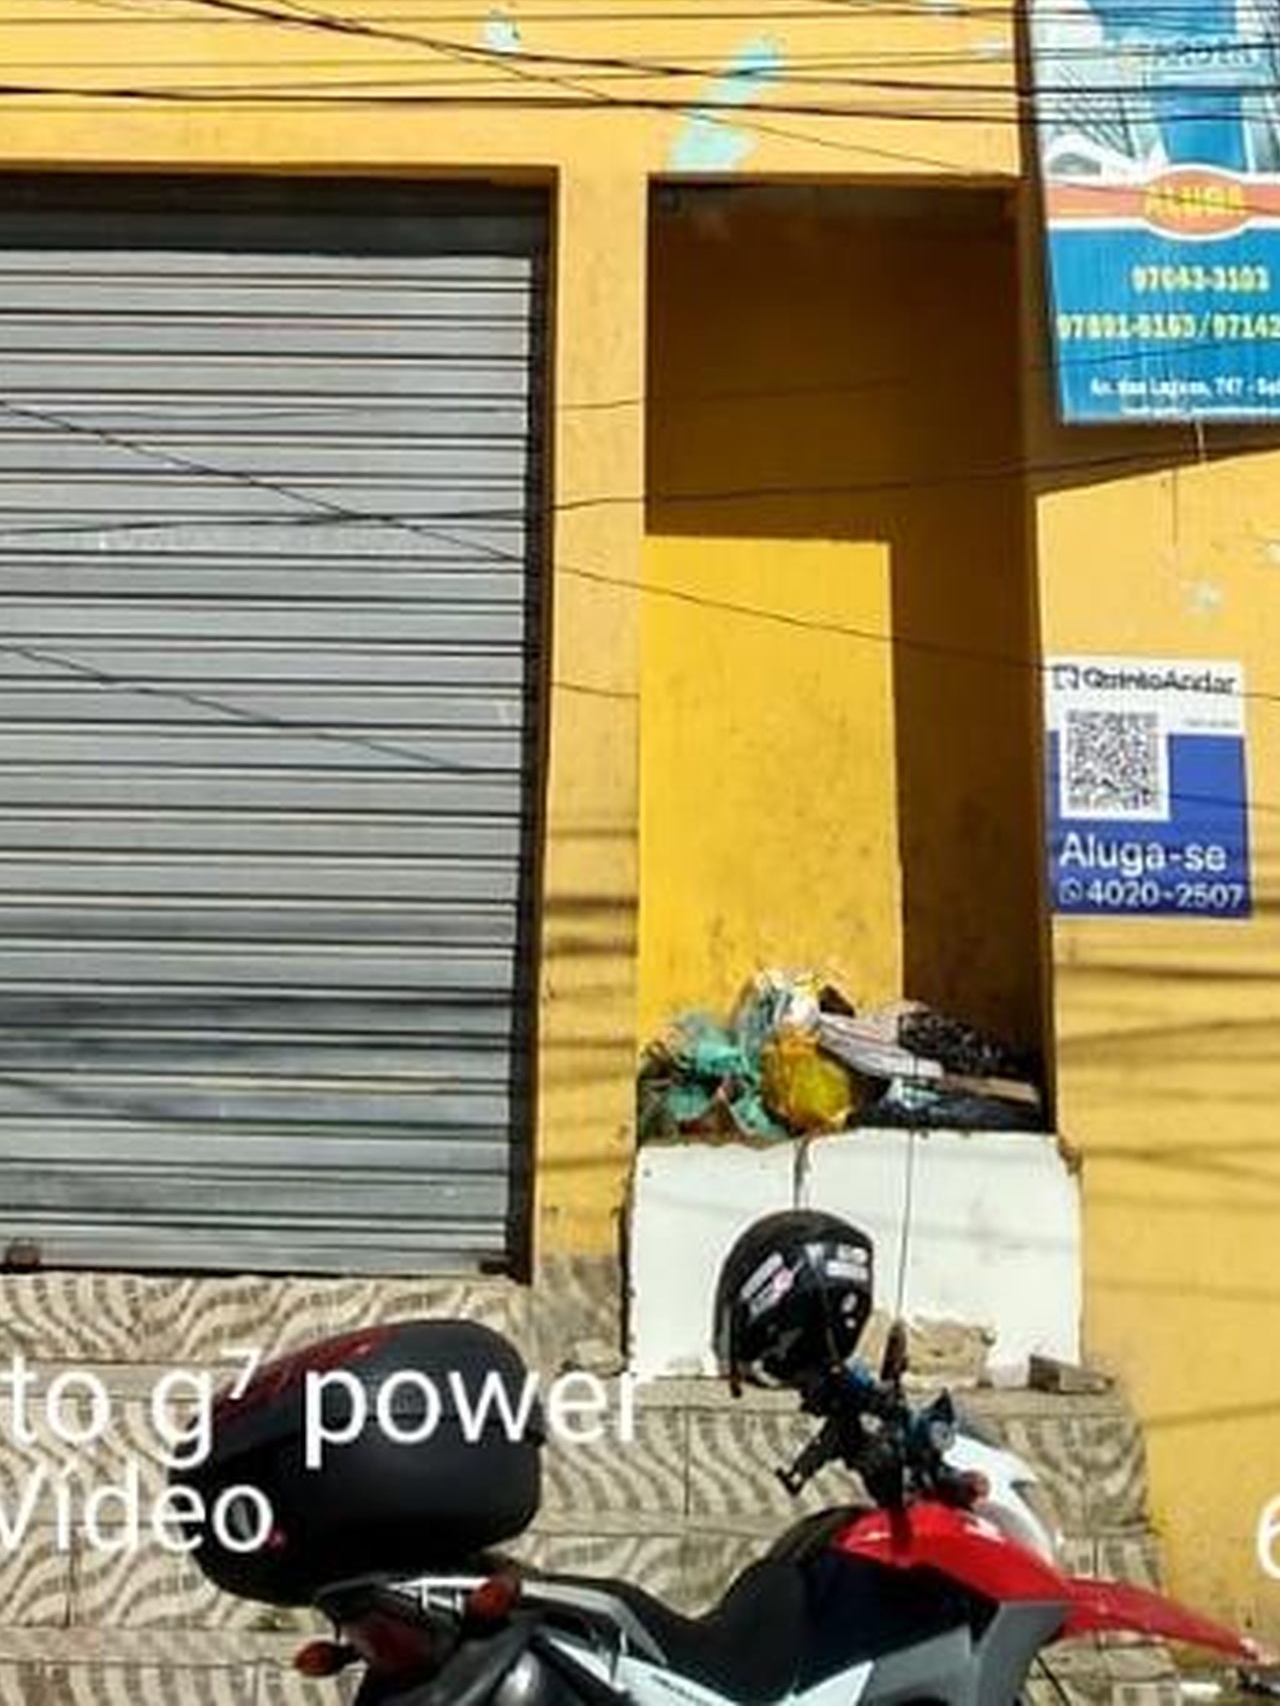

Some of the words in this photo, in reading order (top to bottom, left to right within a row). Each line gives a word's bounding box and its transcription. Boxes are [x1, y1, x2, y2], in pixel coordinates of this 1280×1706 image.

[1083, 666, 1236, 695] QuintoAndar
[1060, 831, 1227, 878] Aluga-se
[1086, 880, 1243, 909] 4020-2507
